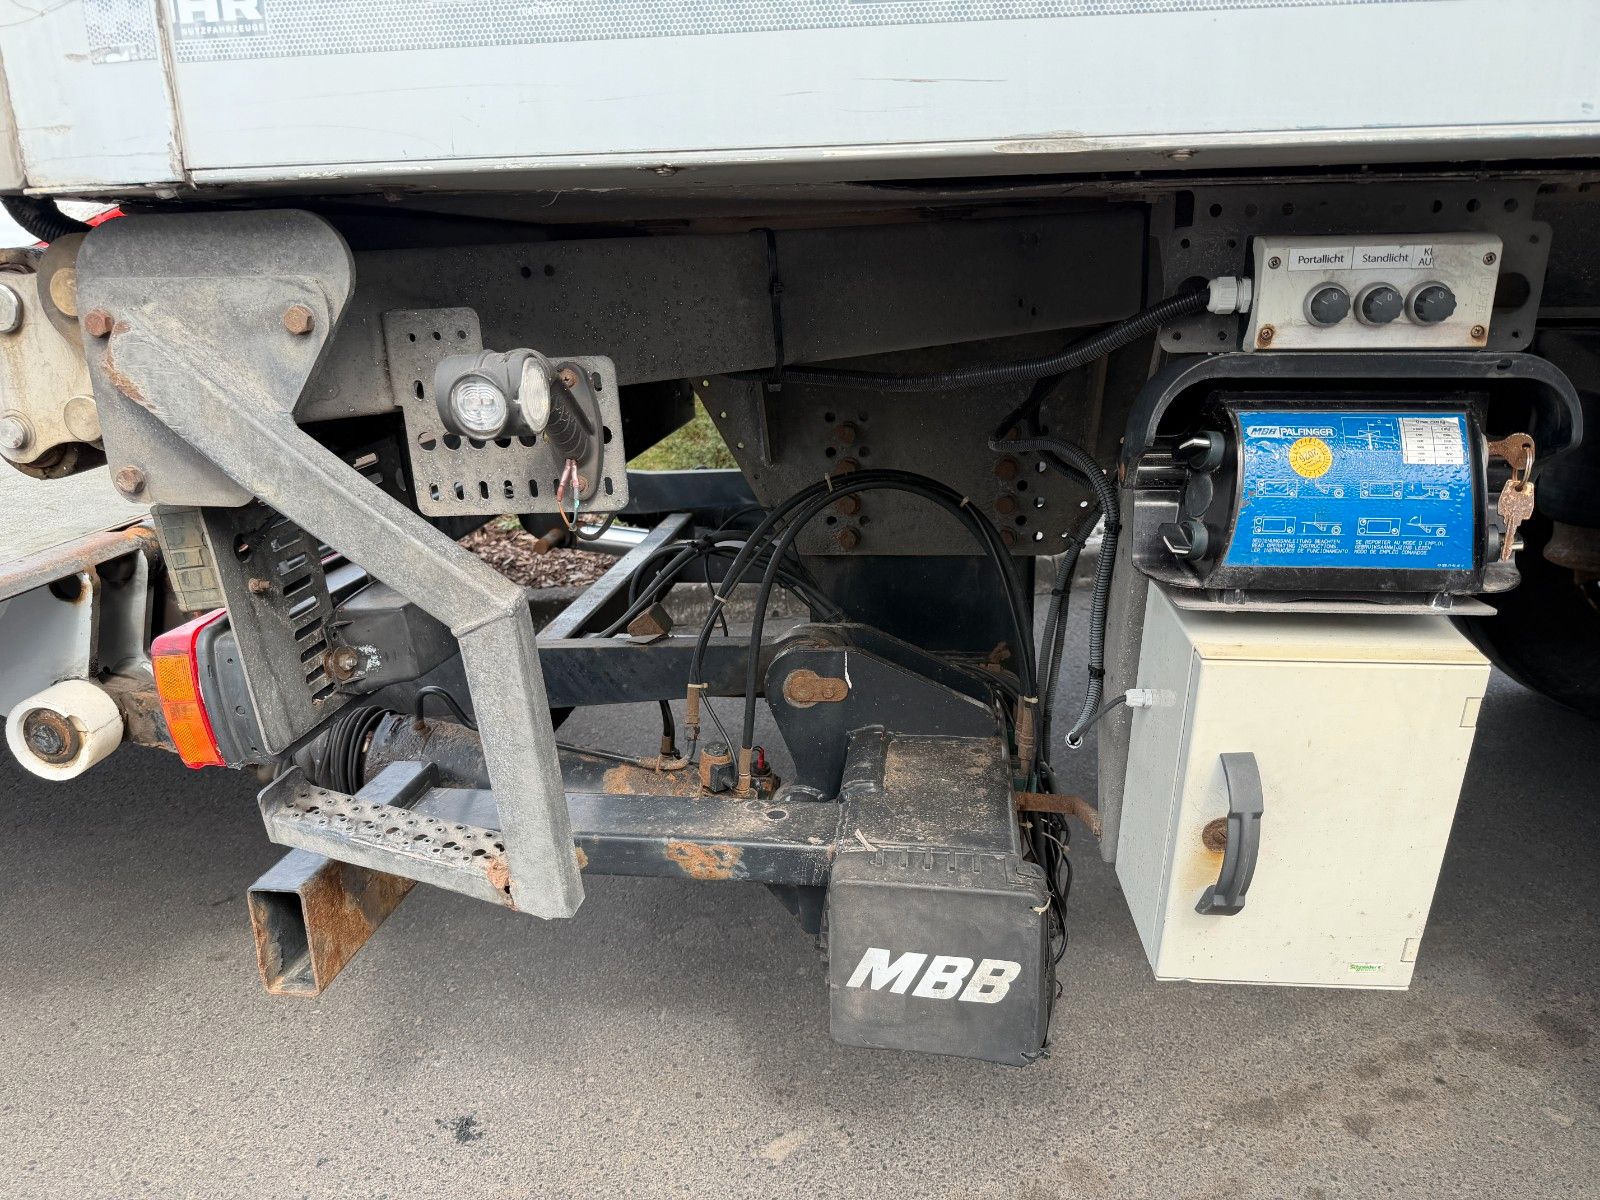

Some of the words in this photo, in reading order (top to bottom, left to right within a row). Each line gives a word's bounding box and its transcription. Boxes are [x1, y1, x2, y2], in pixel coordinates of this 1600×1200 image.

[1297, 254, 1344, 265] Portallicht
[1362, 253, 1409, 264] Standlicht
[1279, 427, 1334, 437] PALFINGER
[845, 946, 1022, 1004] MBB
